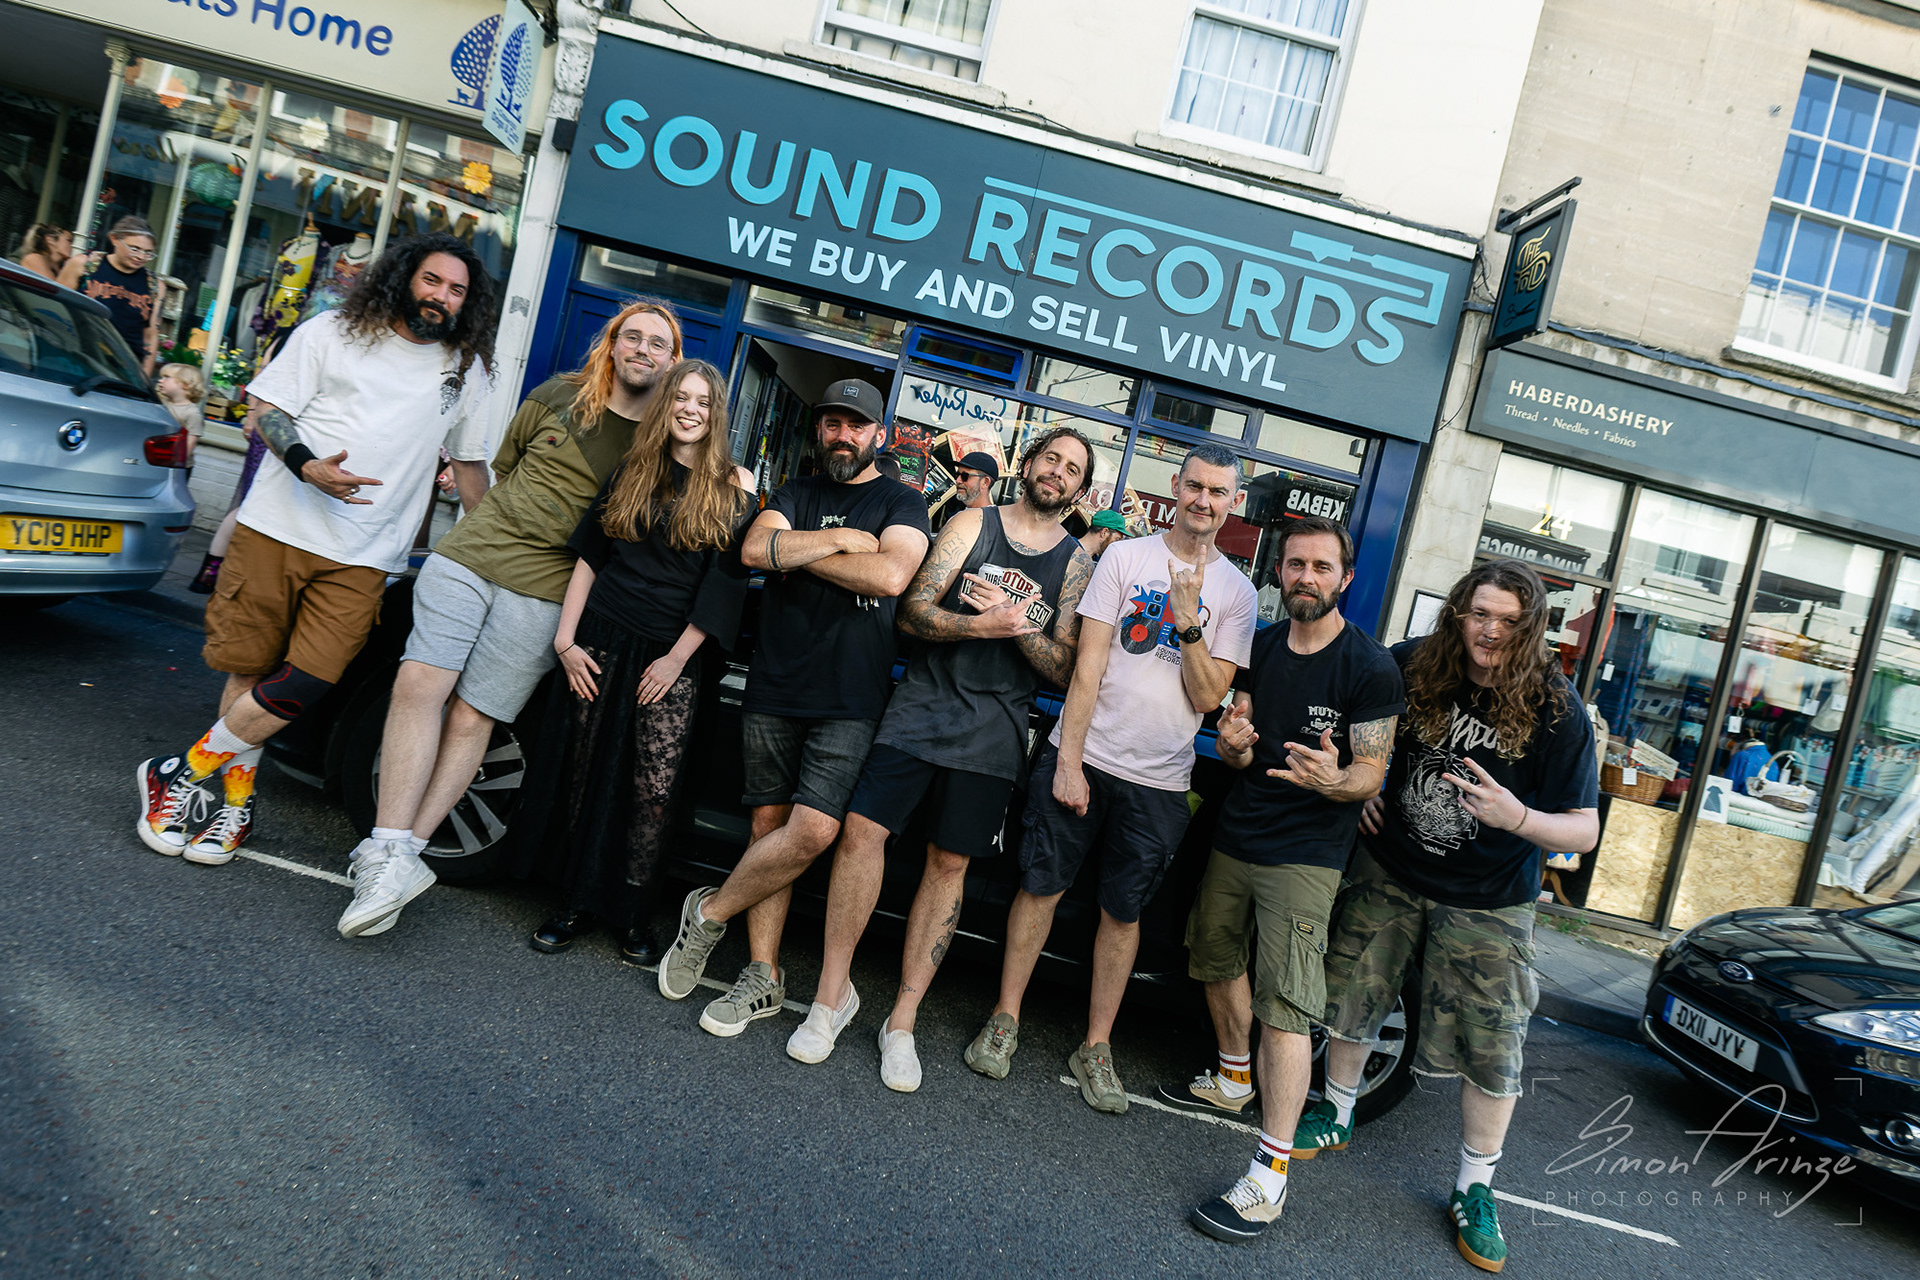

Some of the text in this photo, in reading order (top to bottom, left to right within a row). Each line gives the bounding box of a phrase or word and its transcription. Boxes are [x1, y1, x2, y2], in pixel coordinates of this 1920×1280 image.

[251, 0, 393, 56] Home
[594, 98, 1447, 366] SOUND RECORDS
[1516, 226, 1551, 269] THE
[728, 216, 1287, 392] WE BUY AND SELL VINYL
[1504, 403, 1637, 448] Thread Needles Fabrics
[1508, 379, 1674, 436] HABERDASHERY
[11, 519, 112, 548] YC19 HHP
[1529, 502, 1573, 541] 24
[1002, 571, 1034, 594] OTOR
[1676, 1005, 1745, 1059] DX11 JYV
